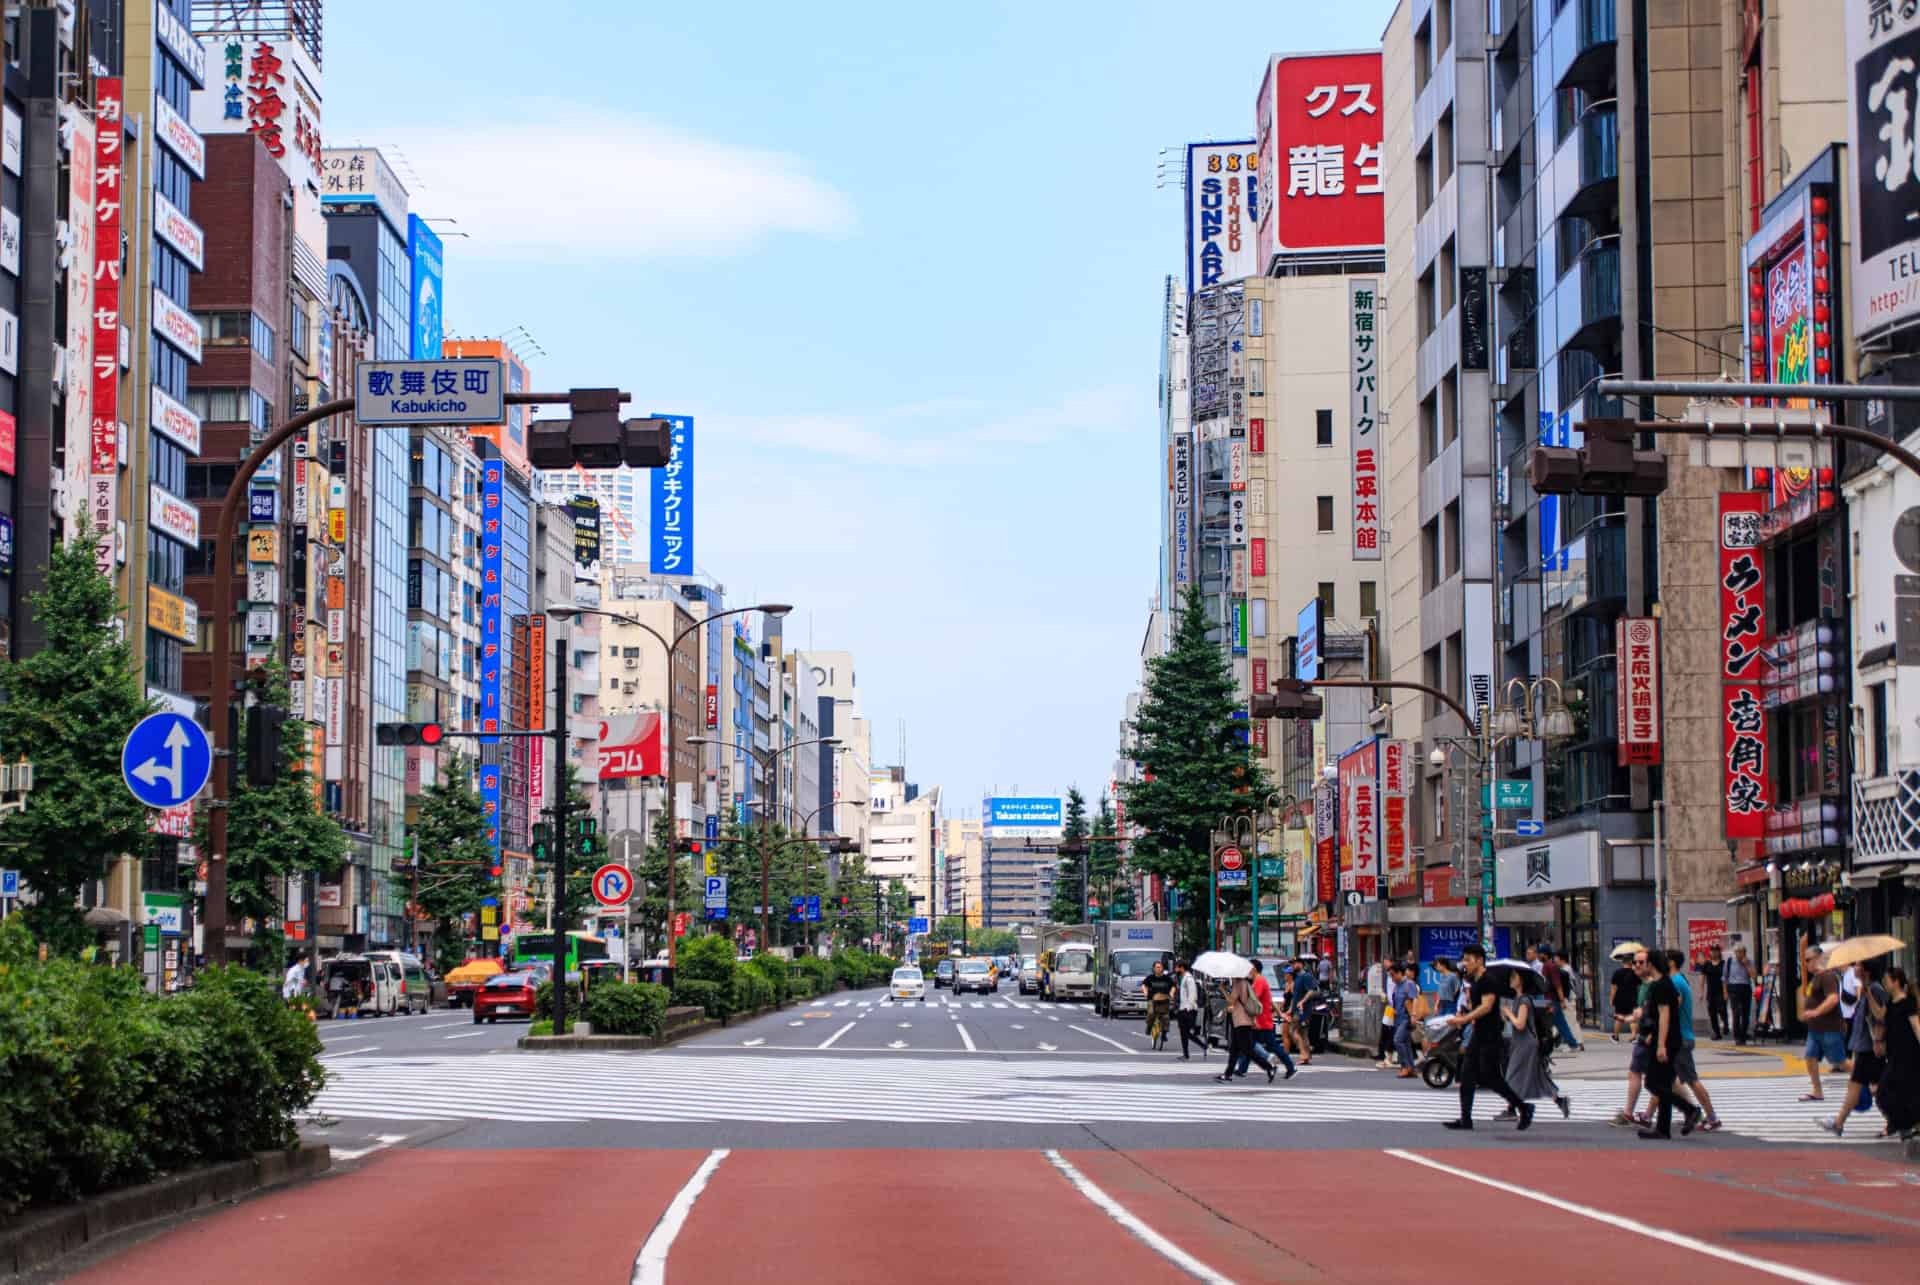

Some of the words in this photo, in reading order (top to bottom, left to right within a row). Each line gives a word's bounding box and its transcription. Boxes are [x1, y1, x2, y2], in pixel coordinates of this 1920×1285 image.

[96, 98, 120, 221] カラオケ
[1200, 177, 1224, 287] SUNPARK
[94, 259, 119, 380] パセラ
[1354, 289, 1375, 437] 新宿サンパーク
[367, 369, 489, 396] 歌舞伎町
[391, 399, 467, 413] Kabukicho
[1355, 447, 1377, 550] 三平本館
[1724, 555, 1761, 677] ラーメン
[1356, 785, 1373, 869] 三平ストア
[708, 879, 720, 895] P
